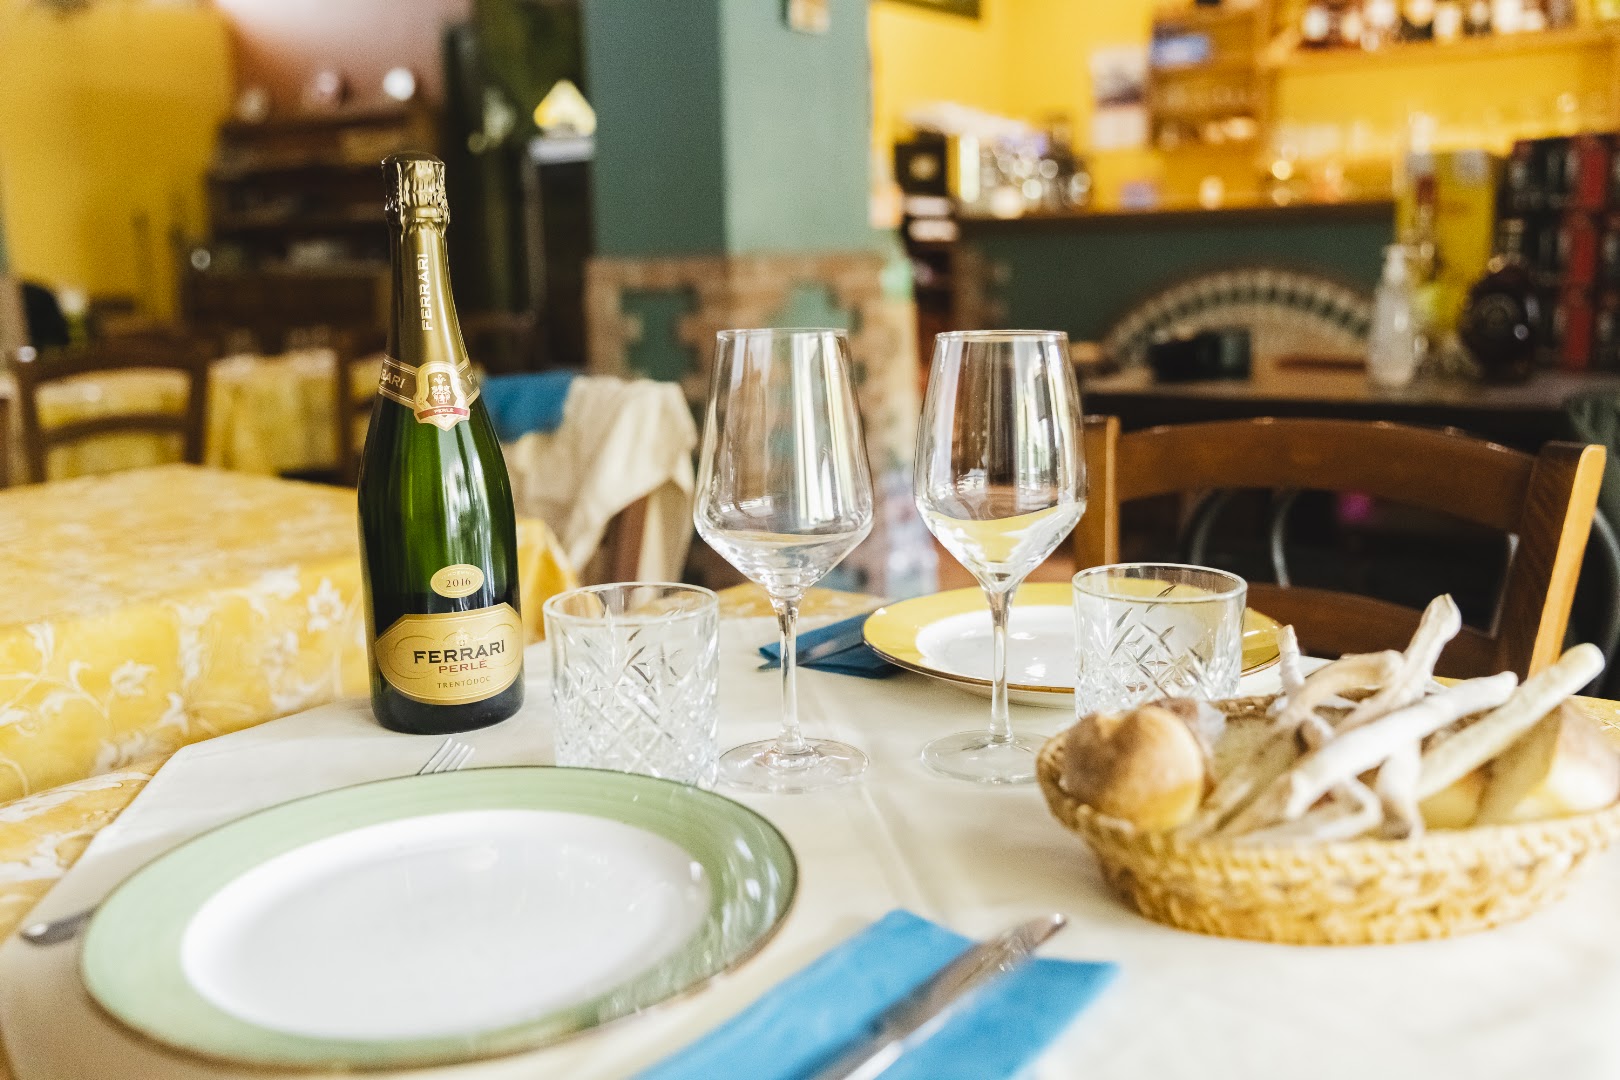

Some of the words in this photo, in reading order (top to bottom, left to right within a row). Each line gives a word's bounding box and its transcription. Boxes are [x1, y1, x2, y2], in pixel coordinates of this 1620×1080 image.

[417, 253, 433, 331] FERRARI
[445, 578, 471, 588] 2016
[413, 639, 505, 664] FERRARI
